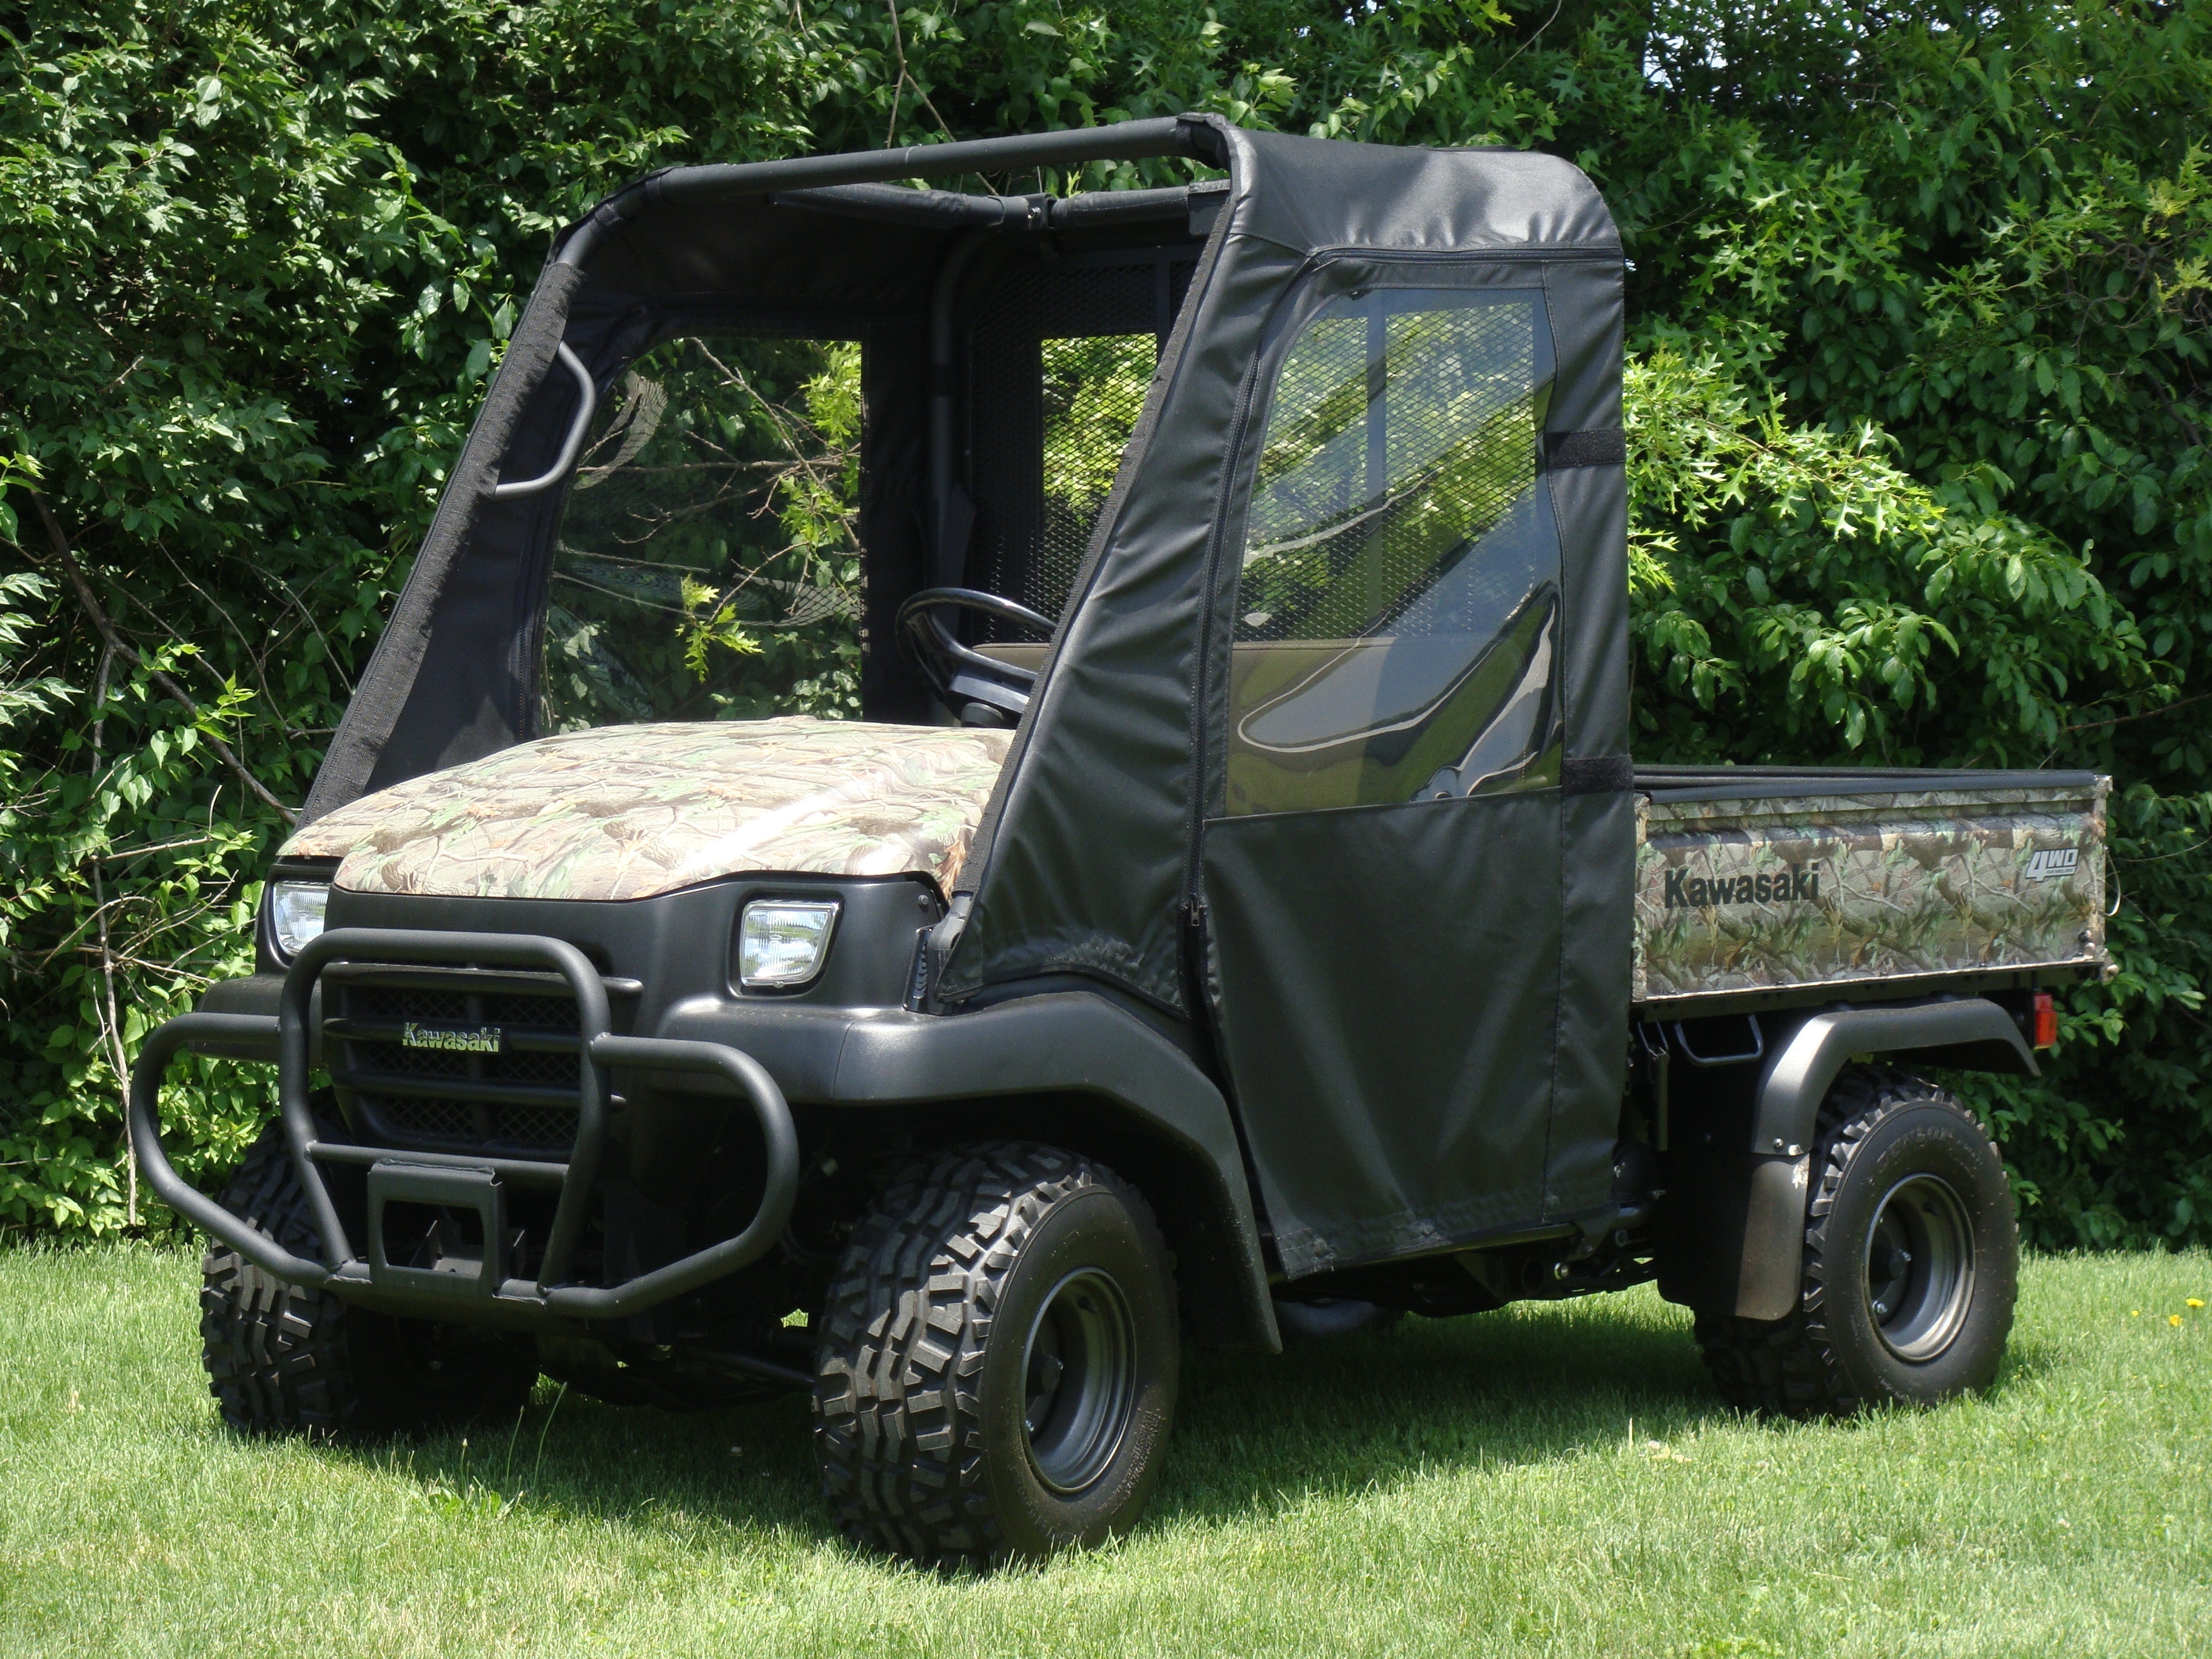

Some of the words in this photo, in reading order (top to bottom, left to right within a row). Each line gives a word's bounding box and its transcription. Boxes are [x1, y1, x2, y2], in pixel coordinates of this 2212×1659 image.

[2026, 848, 2079, 882] 4WD
[1664, 863, 1819, 909] Kawasaki
[402, 1022, 500, 1052] Kawasaki
